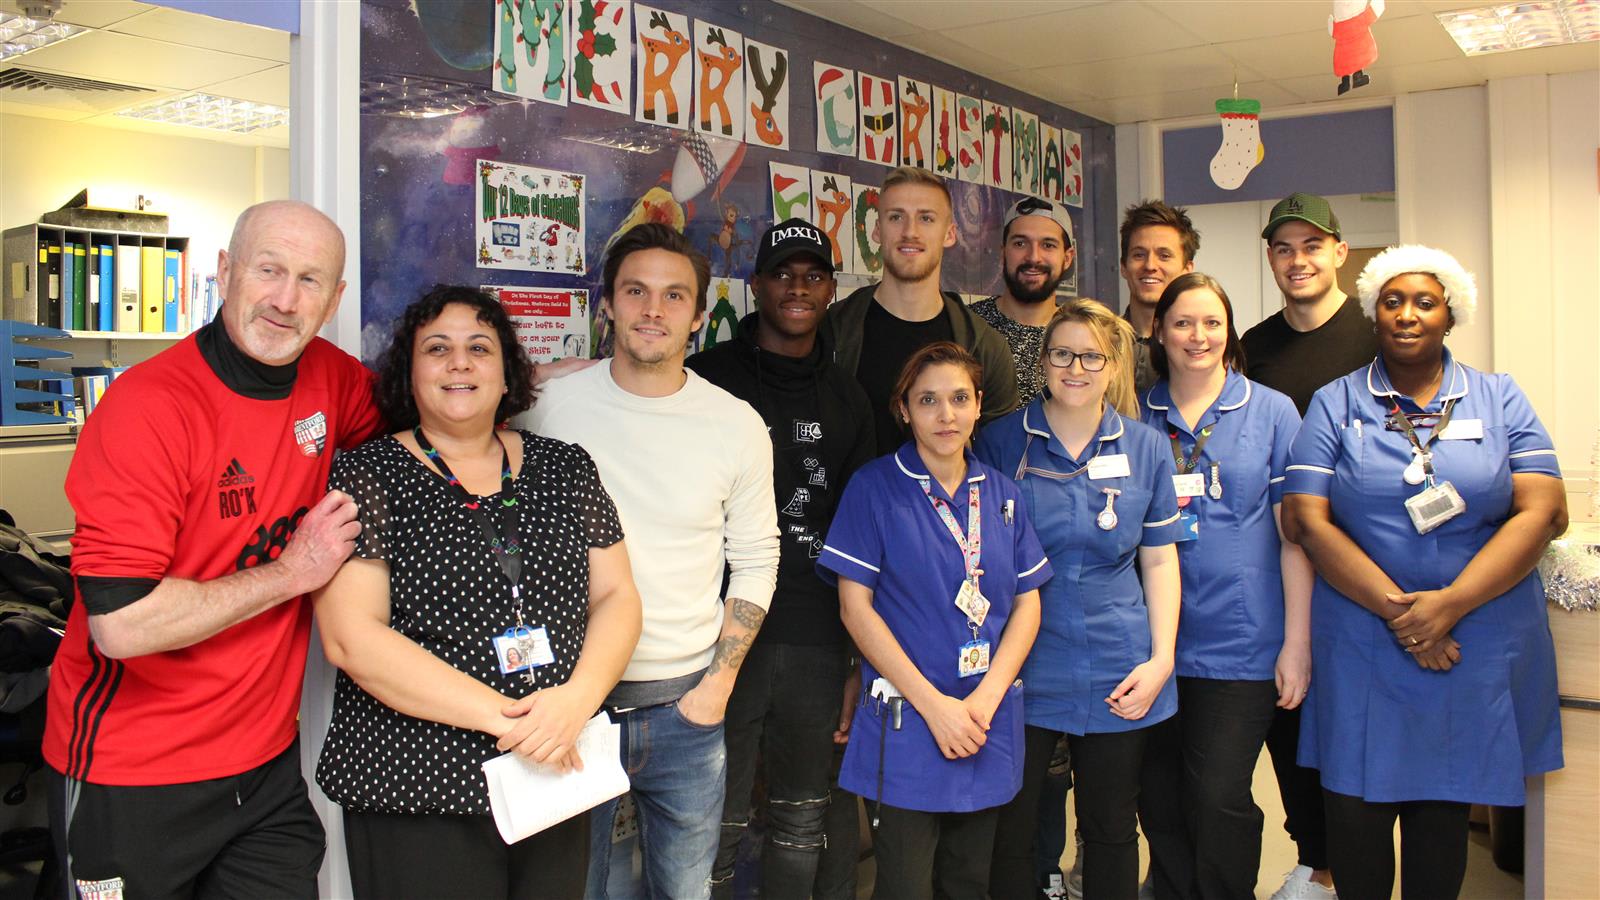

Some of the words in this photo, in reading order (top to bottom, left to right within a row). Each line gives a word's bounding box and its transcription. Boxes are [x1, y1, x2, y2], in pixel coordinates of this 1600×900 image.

[495, 0, 788, 146] MERRY
[818, 67, 1082, 203] CHRISTMAS
[541, 193, 580, 233] Christmas
[771, 226, 822, 247] [MXL]
[218, 475, 254, 488] adidas
[790, 525, 805, 533] THE
